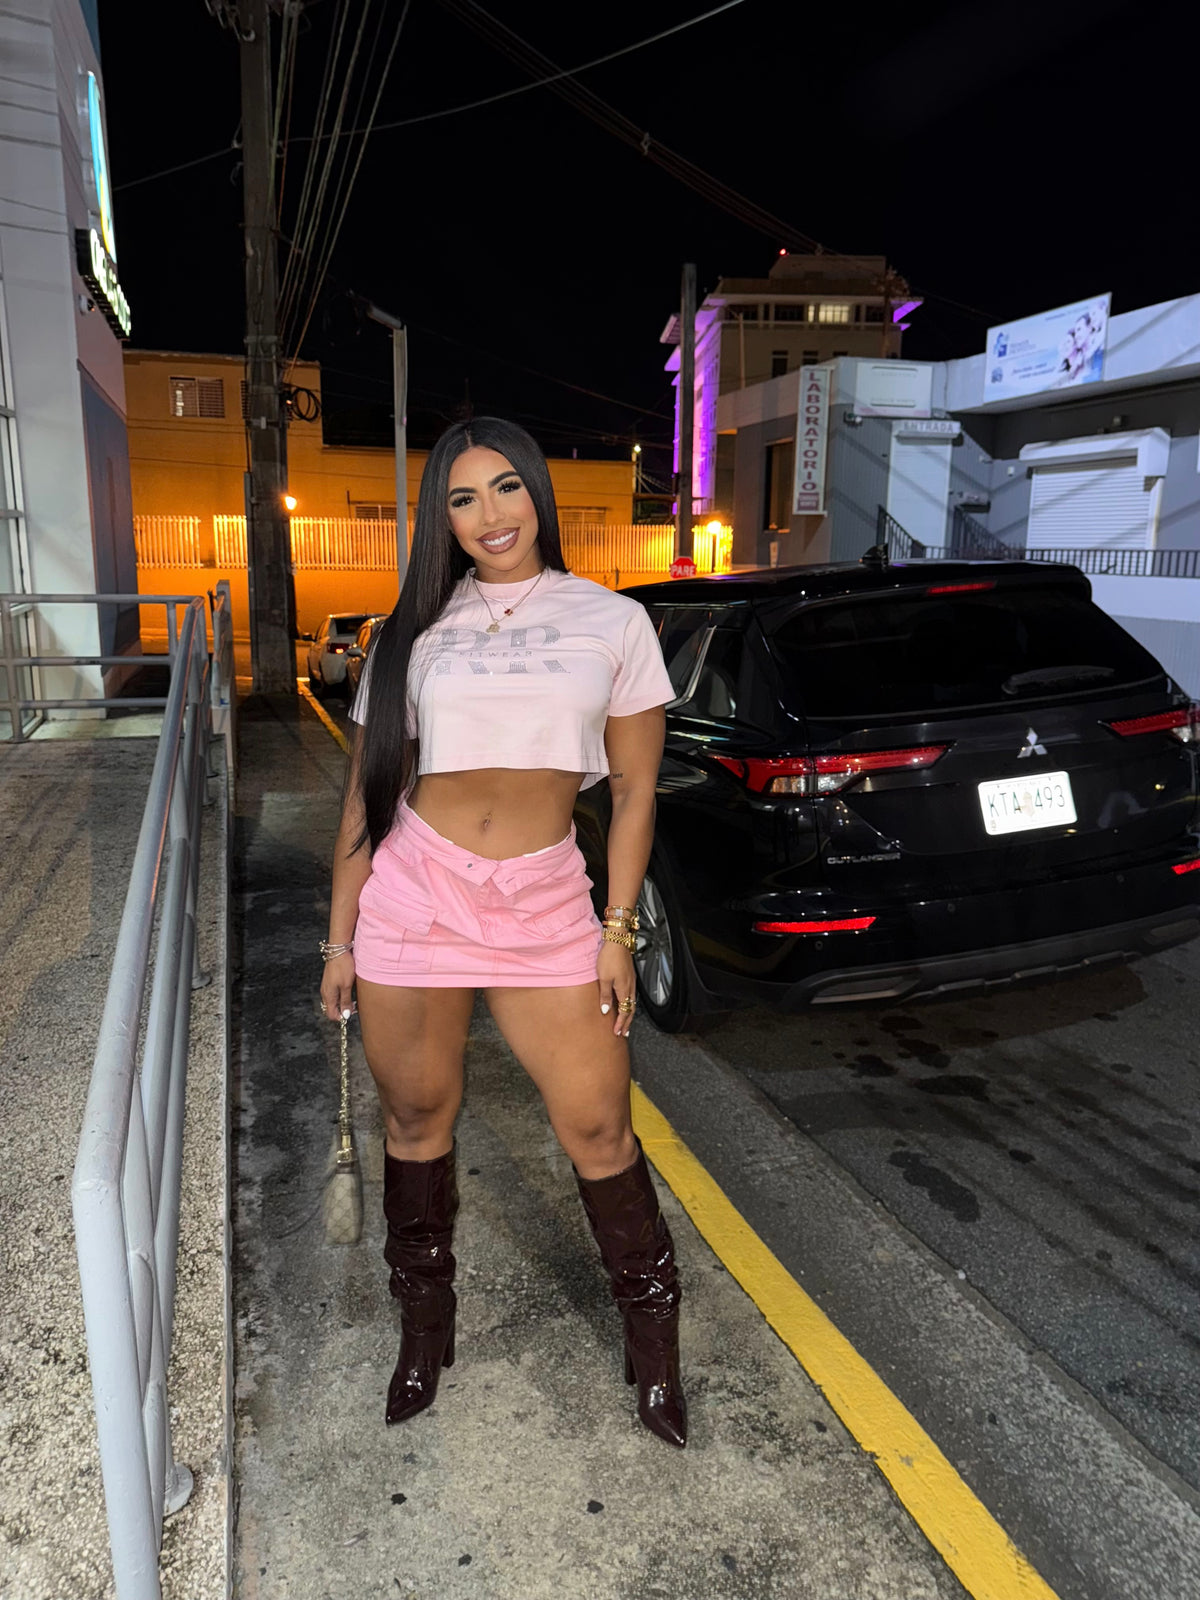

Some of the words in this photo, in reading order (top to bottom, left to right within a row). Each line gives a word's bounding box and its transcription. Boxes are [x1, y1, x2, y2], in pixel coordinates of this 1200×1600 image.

[801, 372, 821, 491] LABORATORIO
[903, 421, 954, 432] ENTRADA
[671, 564, 696, 577] PARE
[987, 790, 1023, 818] KTA
[1034, 784, 1066, 809] 493
